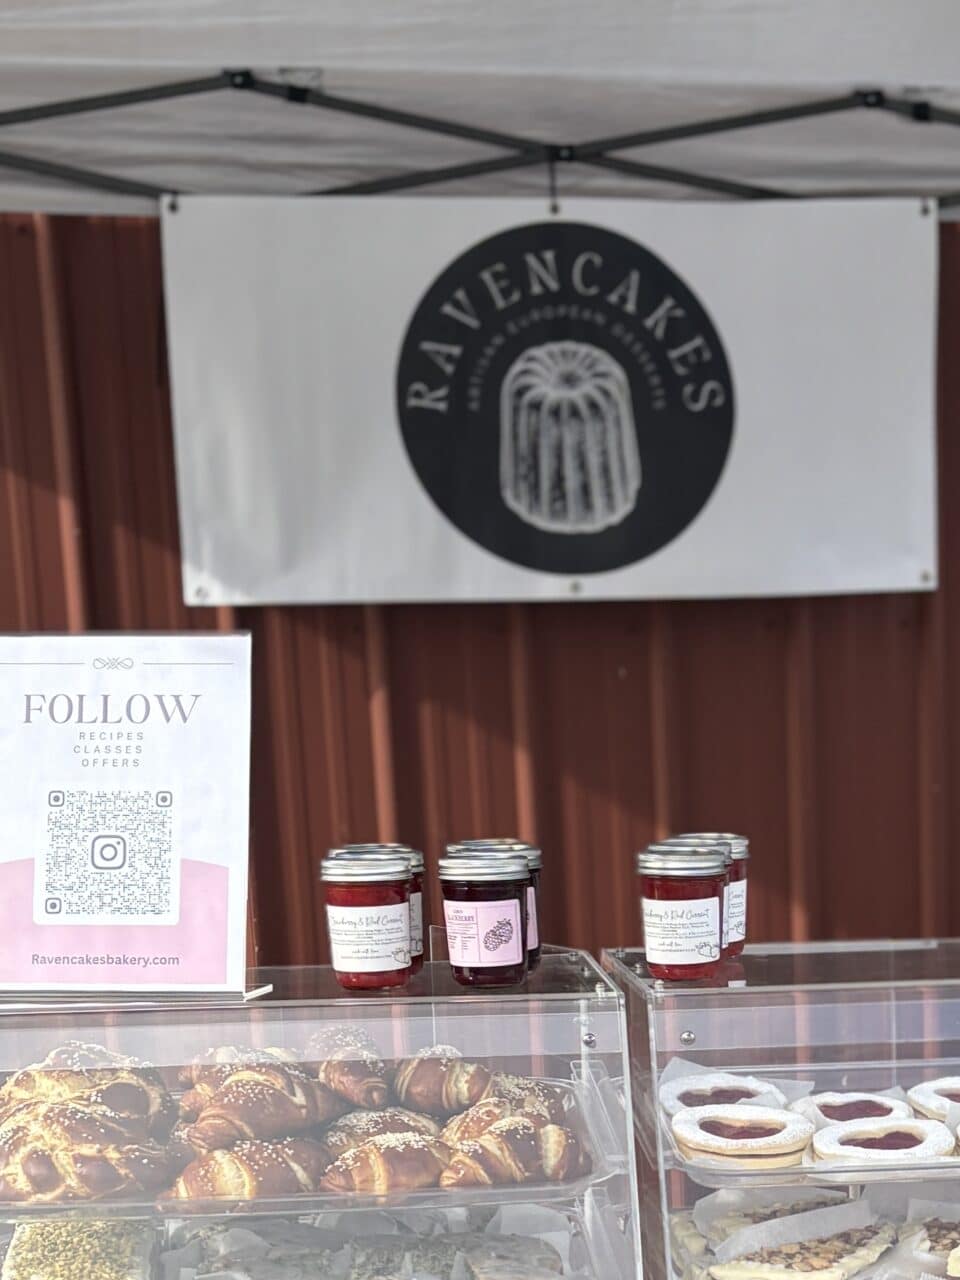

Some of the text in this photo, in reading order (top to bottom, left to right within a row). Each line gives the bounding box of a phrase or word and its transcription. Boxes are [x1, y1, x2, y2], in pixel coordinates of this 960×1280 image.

[405, 248, 726, 413] RAVENCAKES
[24, 694, 201, 724] FOLLOW
[78, 731, 144, 741] RECIPES
[73, 744, 143, 754] CLASSES
[81, 758, 140, 768] OFFERS
[31, 953, 180, 968] Ravencakesbakery.com
